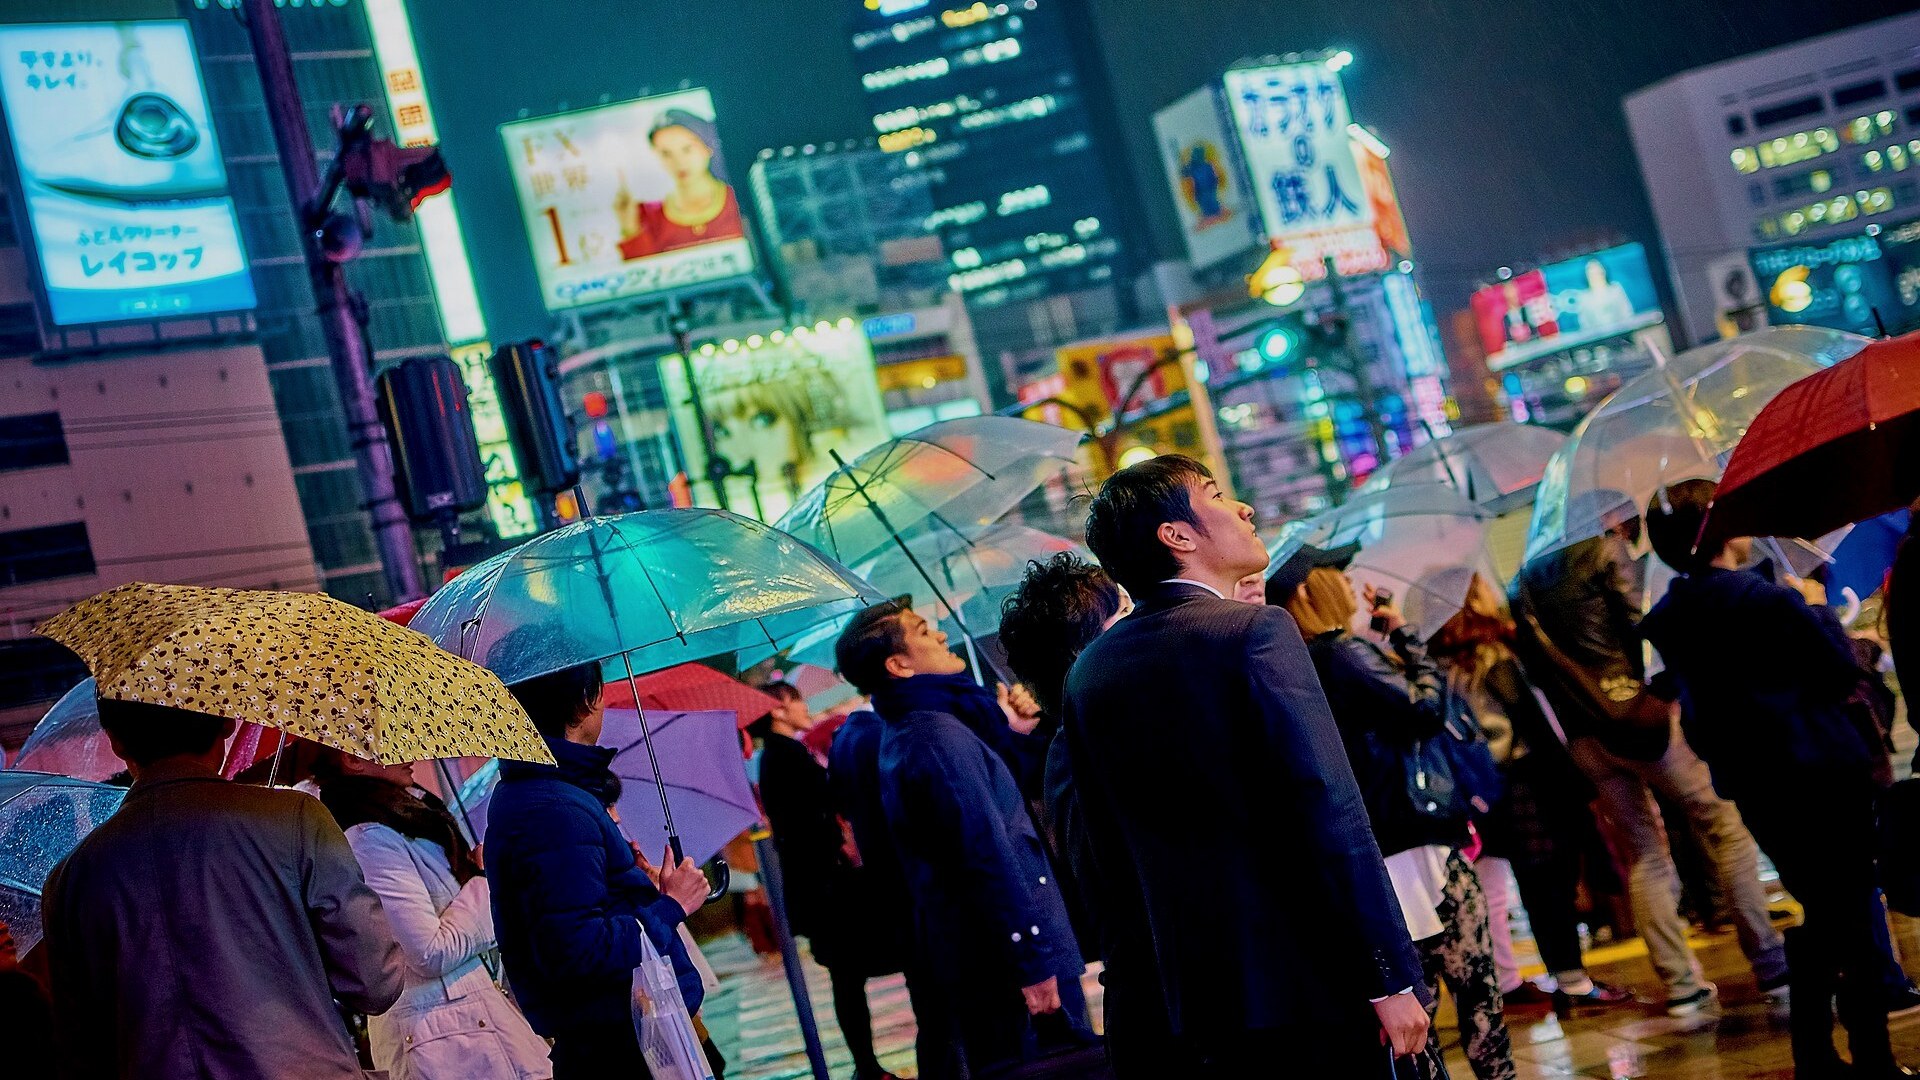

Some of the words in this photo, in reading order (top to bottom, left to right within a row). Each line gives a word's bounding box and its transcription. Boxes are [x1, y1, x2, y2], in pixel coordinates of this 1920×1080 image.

[1294, 134, 1314, 167] の
[1271, 162, 1358, 225] 鉄人
[80, 246, 204, 277] レイコップ
